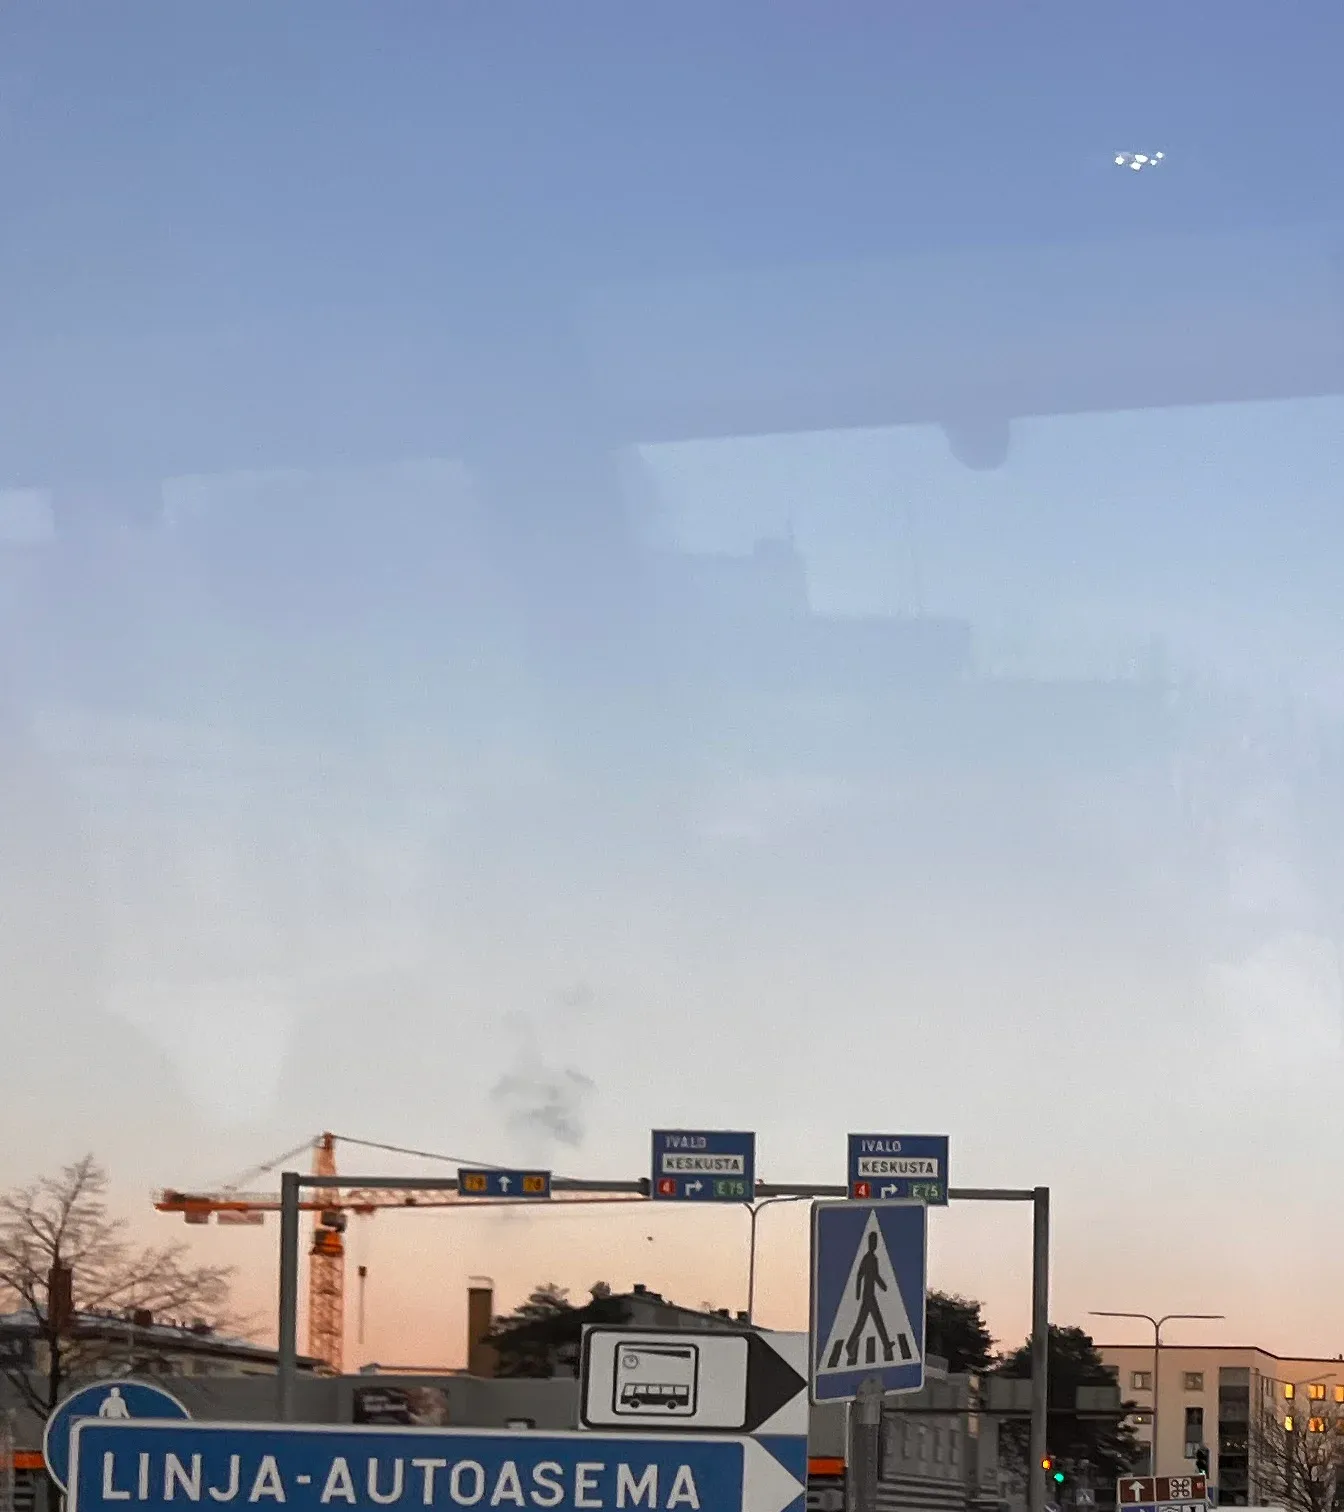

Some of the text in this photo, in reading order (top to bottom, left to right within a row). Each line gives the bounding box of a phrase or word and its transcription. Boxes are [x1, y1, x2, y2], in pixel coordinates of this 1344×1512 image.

[665, 1136, 707, 1148] IVALO
[861, 1140, 901, 1152] IVALO
[665, 1157, 740, 1170] KESKUSTA
[861, 1160, 934, 1173] KESKUSTA
[858, 1183, 866, 1196] 4
[102, 1451, 700, 1509] LINJA-AUTOASEMA
